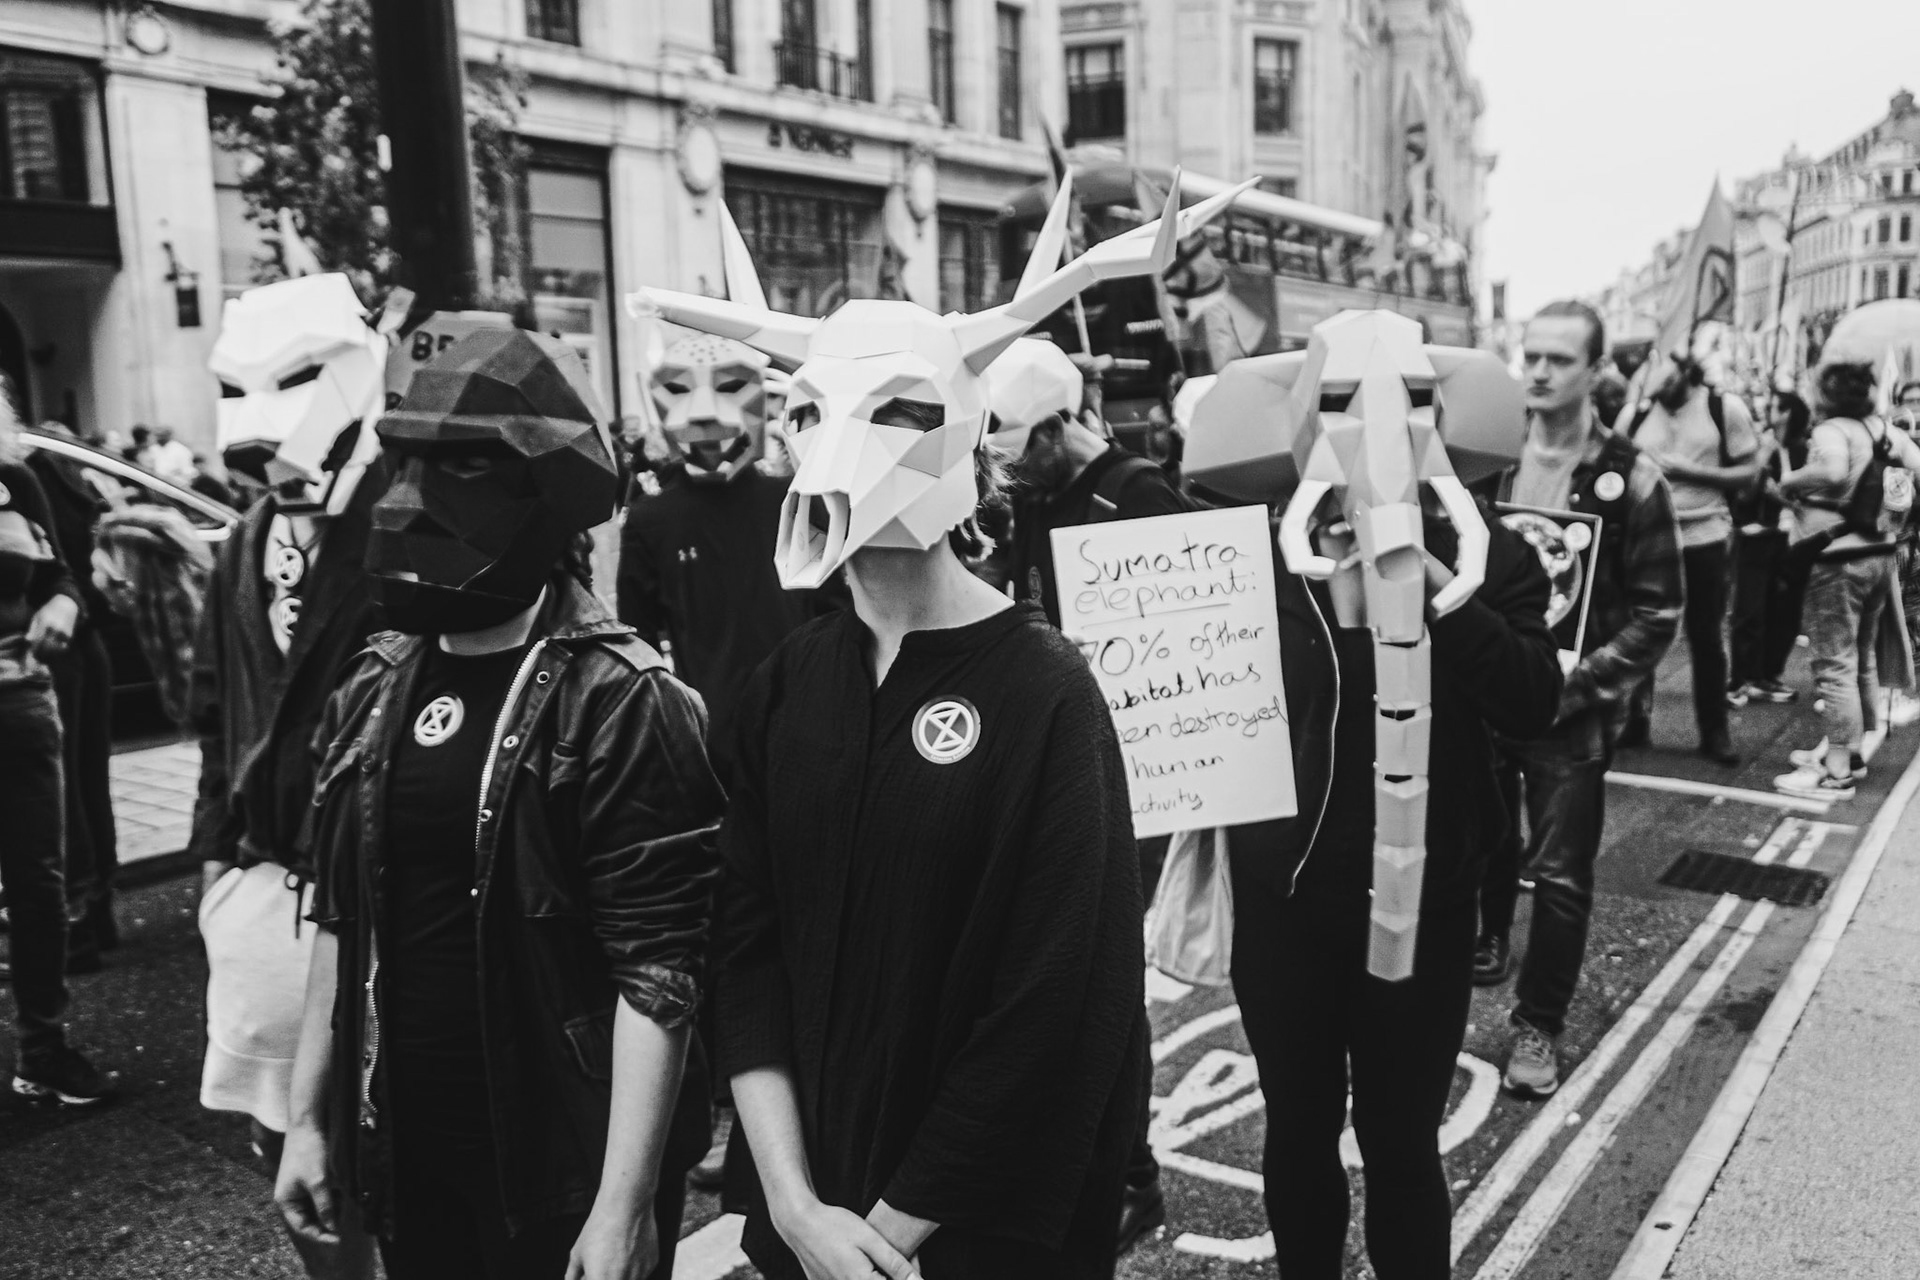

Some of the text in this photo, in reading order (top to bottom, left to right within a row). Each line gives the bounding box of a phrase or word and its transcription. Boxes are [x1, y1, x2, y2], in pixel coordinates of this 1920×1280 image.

[1079, 532, 1249, 584] Sumatra
[1075, 568, 1256, 618] elephant:
[1078, 620, 1264, 676] 70% of their
[1109, 662, 1262, 711] abitat has
[1170, 695, 1289, 738] destroyed
[1133, 788, 1204, 811] ctivity
